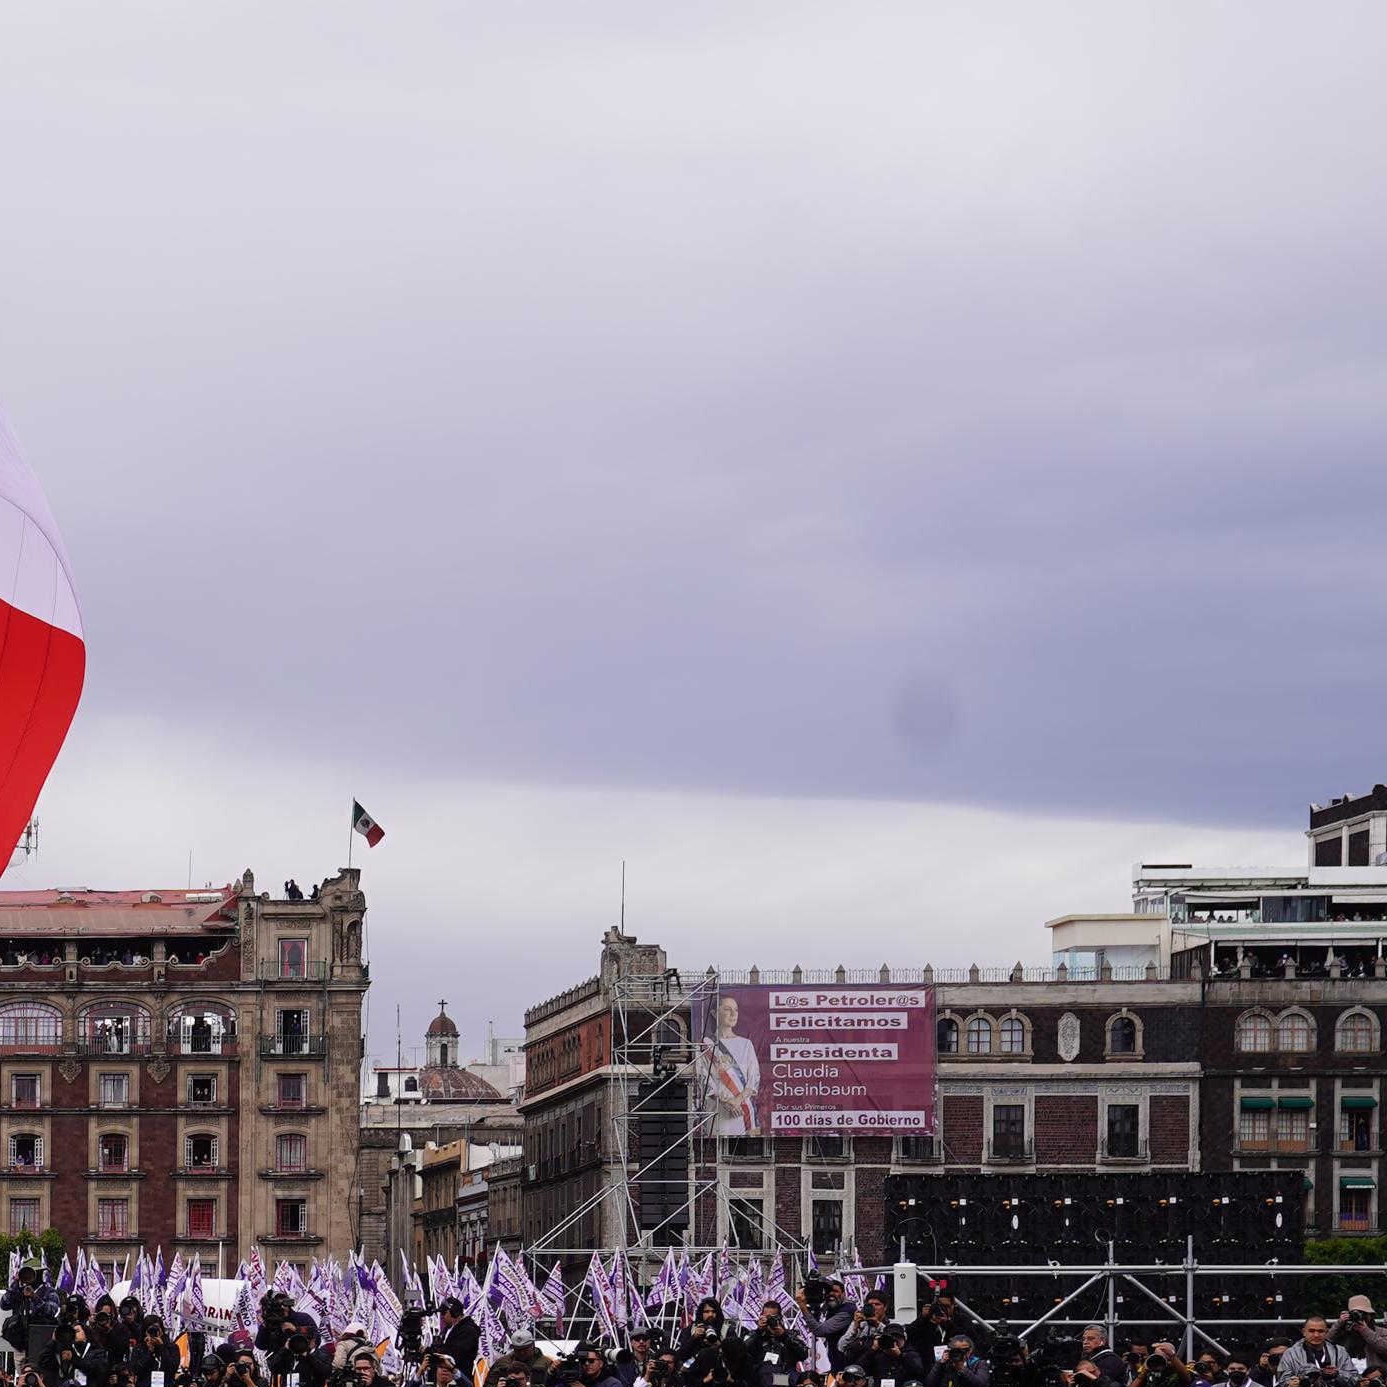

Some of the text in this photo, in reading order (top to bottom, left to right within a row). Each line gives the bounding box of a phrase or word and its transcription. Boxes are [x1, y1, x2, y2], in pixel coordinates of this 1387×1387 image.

[775, 994, 920, 1008] L@s Petroler@s
[774, 1015, 902, 1029] Felicitamos
[776, 1047, 893, 1059] Presidenta
[772, 1063, 839, 1079] Claudia
[772, 1082, 867, 1097] Sheinbaum
[776, 1103, 789, 1111] Por
[804, 1103, 837, 1111] Primeros
[776, 1112, 921, 1127] 100 días de Gobierno
